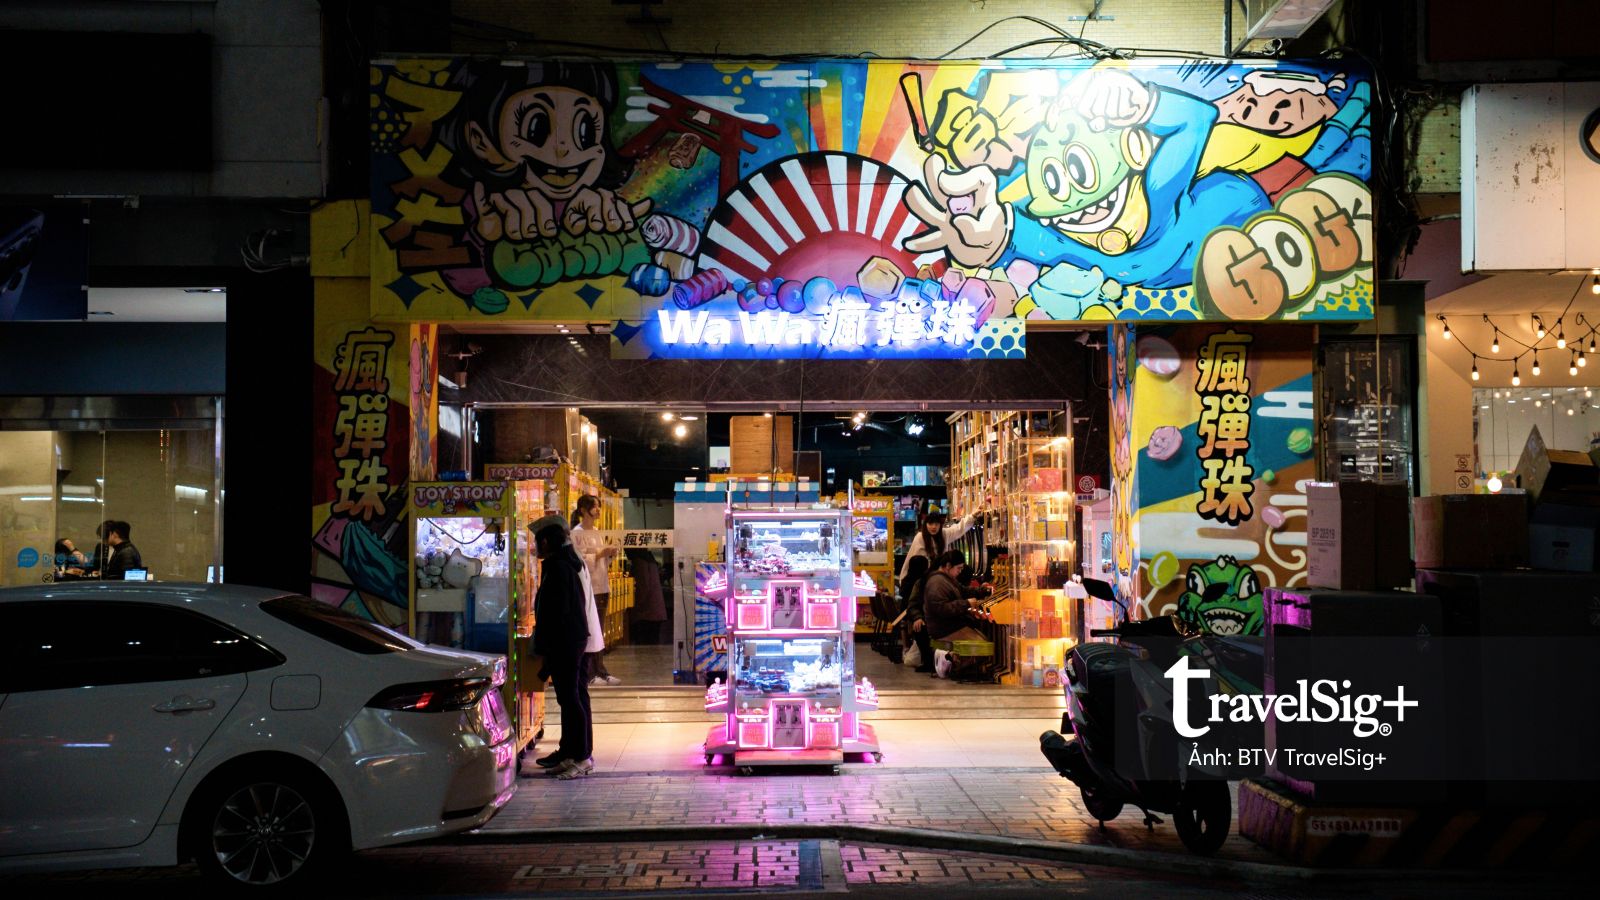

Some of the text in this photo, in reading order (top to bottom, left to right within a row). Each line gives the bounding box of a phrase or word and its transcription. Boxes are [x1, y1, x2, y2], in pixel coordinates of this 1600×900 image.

[657, 298, 977, 347] Wa Wa 瘋彈珠
[332, 326, 394, 522] 瘋彈珠
[1197, 329, 1254, 523] 瘋彈珠
[415, 486, 504, 500] TOY STORY
[490, 466, 557, 478] TOY STORY
